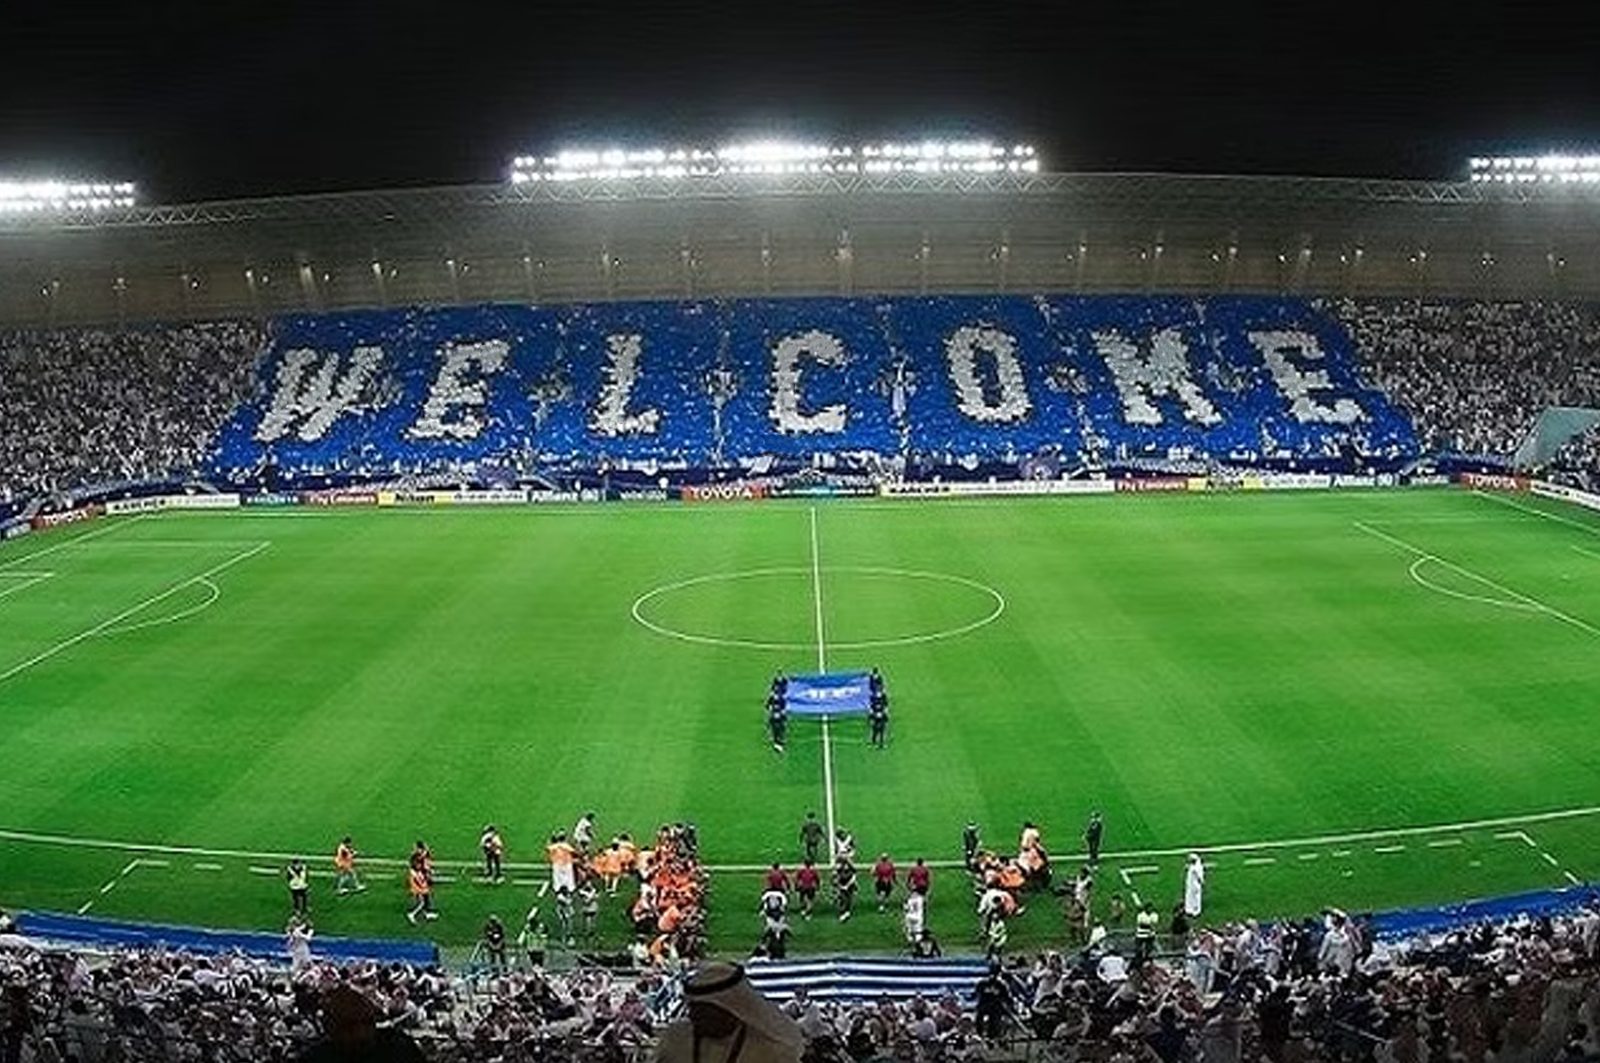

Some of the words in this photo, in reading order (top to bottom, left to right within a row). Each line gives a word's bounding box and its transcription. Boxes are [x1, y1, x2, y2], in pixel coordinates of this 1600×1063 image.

[253, 326, 1363, 441] WELCOME
[1468, 474, 1518, 489] TOYOTA
[690, 485, 753, 499] TOYOTA
